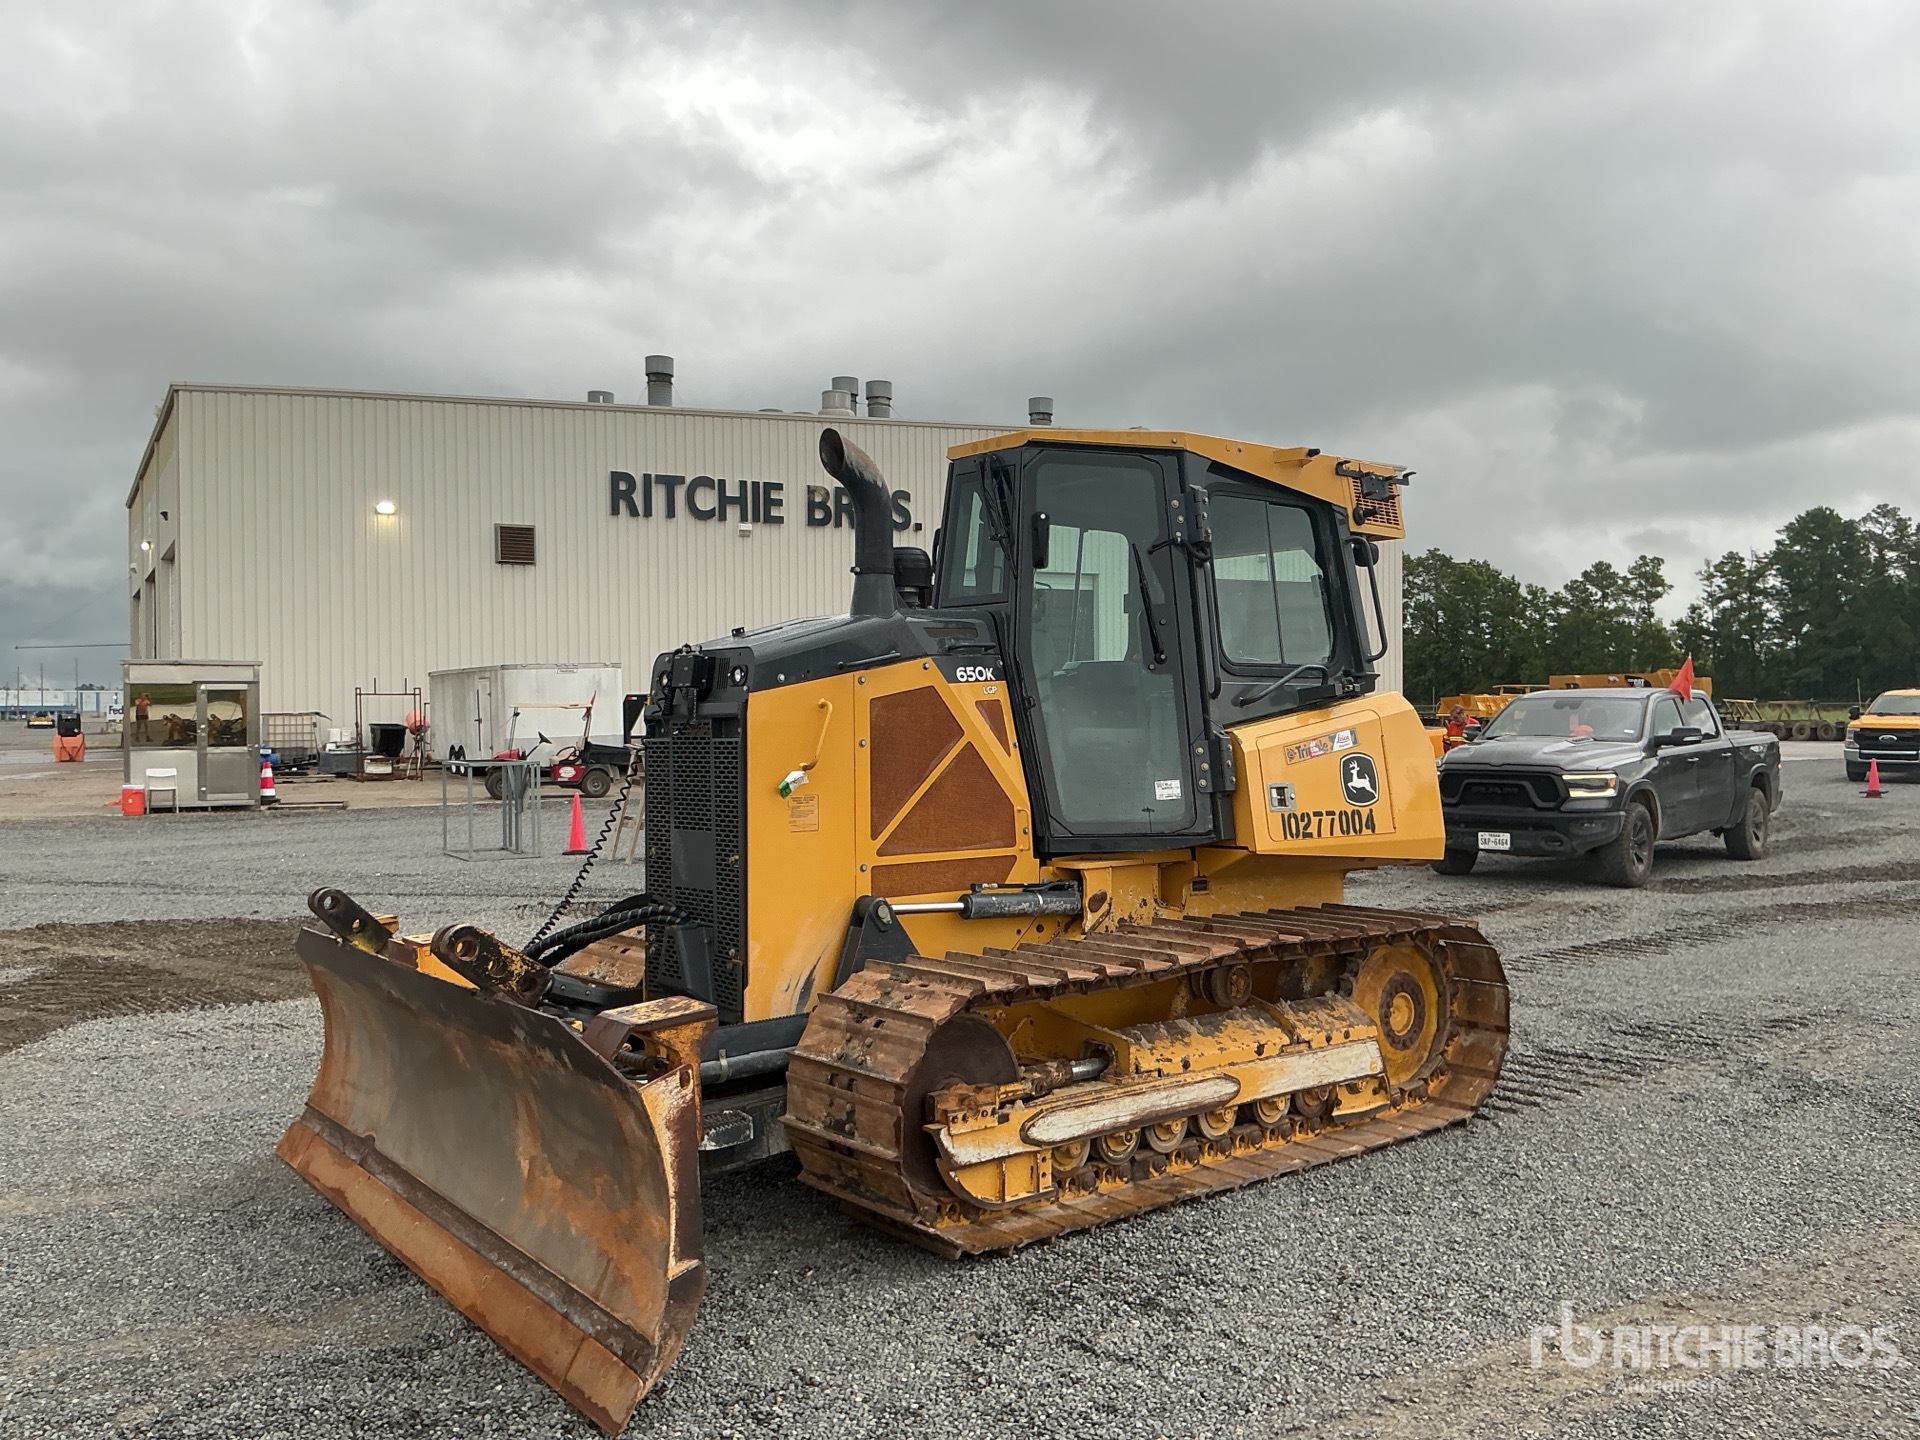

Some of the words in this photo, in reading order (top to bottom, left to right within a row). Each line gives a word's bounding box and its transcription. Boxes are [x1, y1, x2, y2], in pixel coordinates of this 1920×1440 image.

[610, 470, 785, 525] RITCHIE
[806, 484, 923, 531] BRS.
[956, 666, 996, 681] 650K
[983, 685, 998, 694] LGP
[1281, 808, 1376, 840] 10277004
